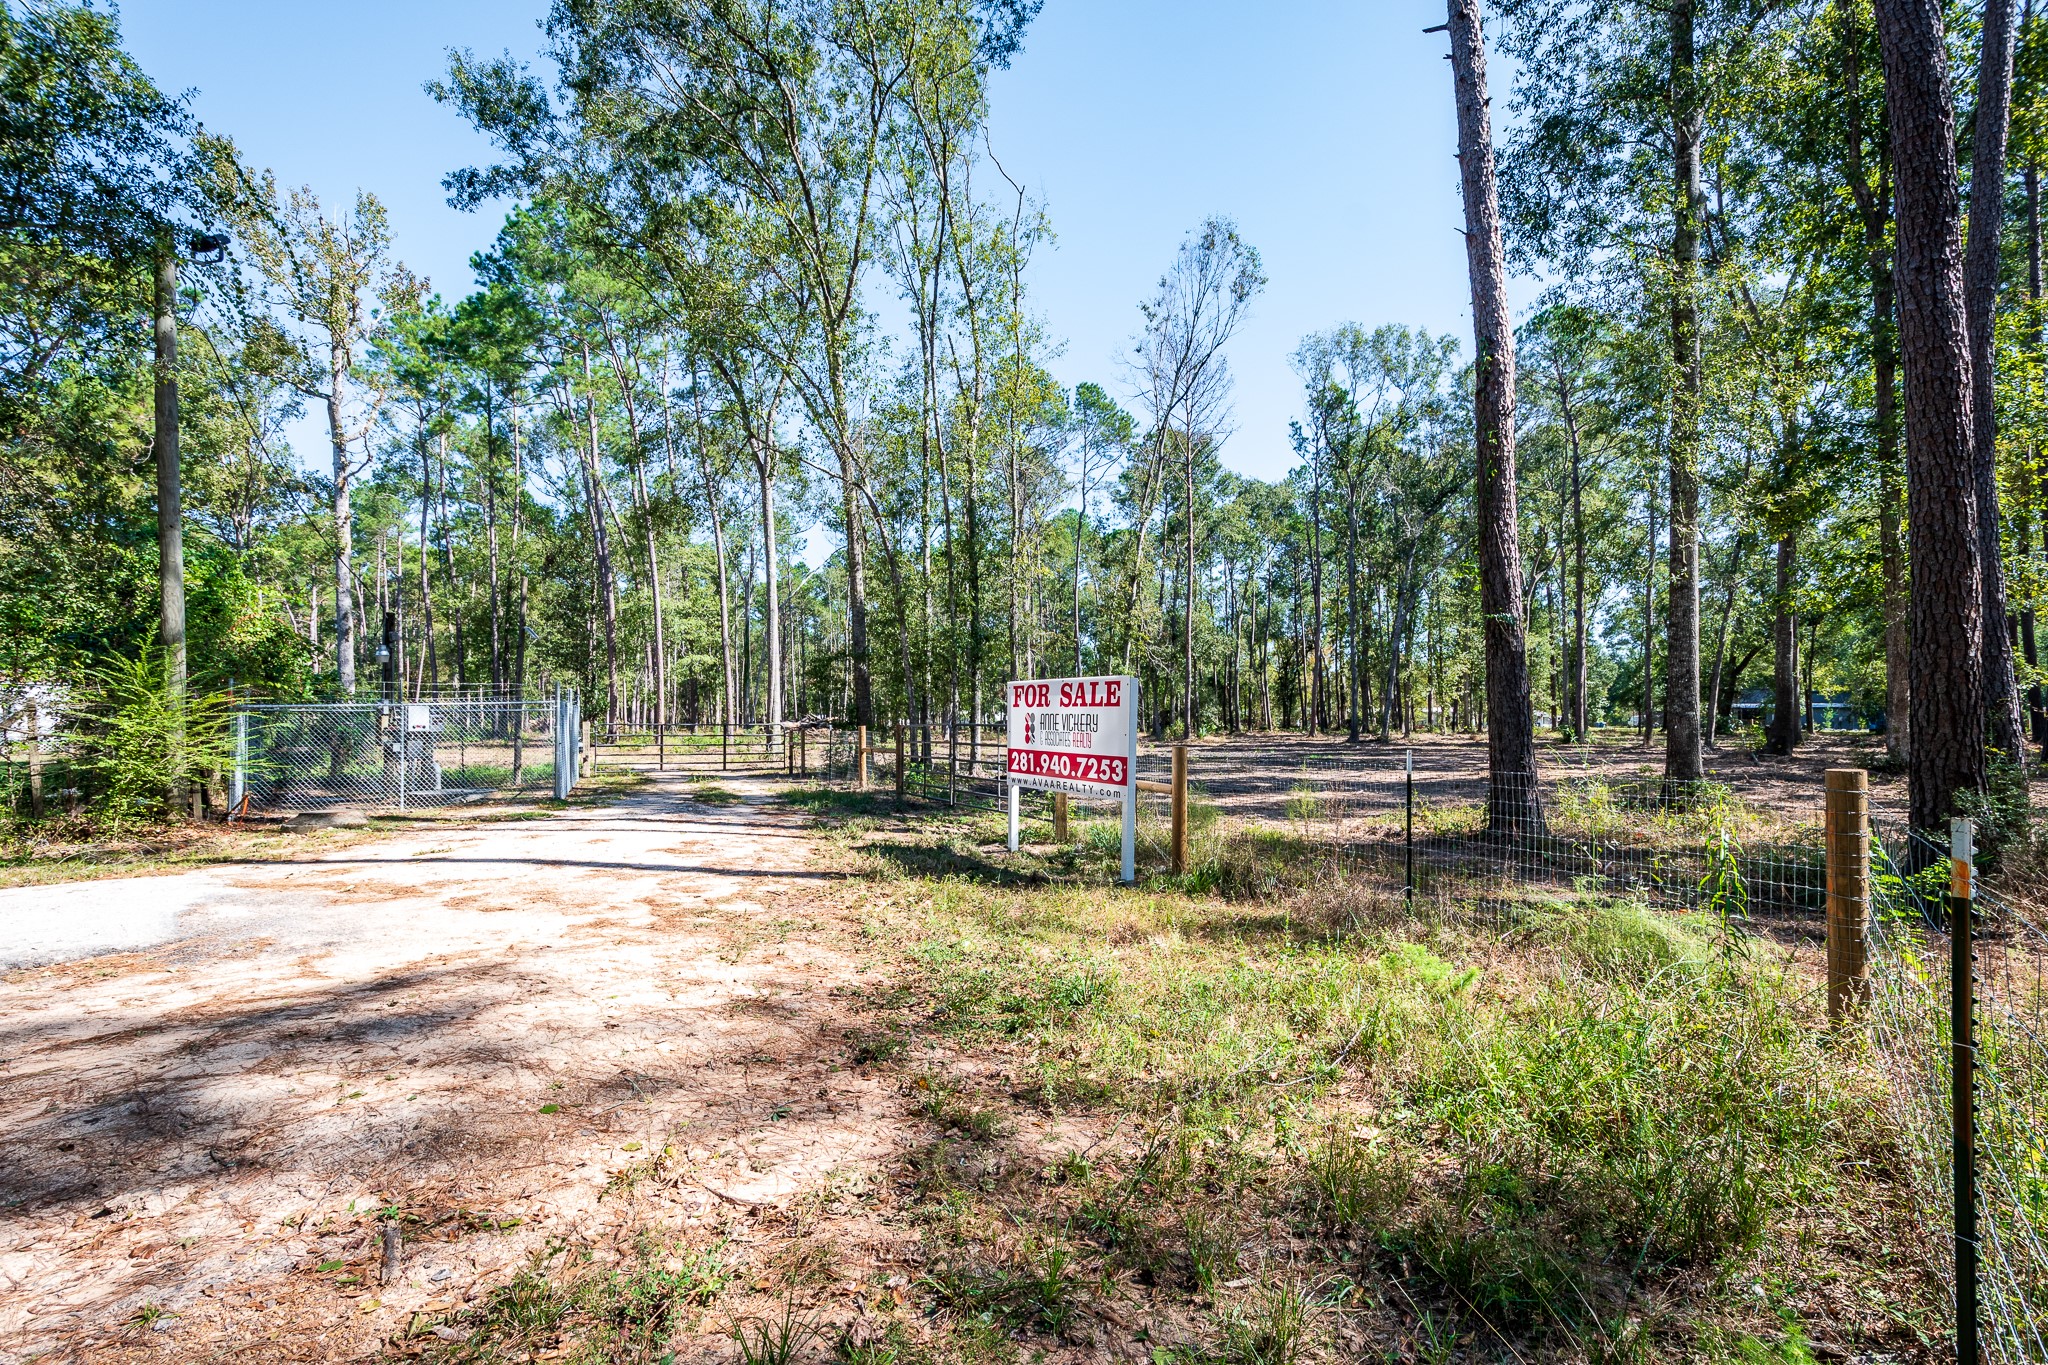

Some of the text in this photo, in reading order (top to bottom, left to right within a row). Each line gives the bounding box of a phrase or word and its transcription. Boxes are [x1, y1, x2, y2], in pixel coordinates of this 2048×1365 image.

[1013, 681, 1121, 708] FOR SALE
[1040, 713, 1099, 733] ANNE VICKERY
[1072, 732, 1092, 748] REALTY
[1011, 751, 1123, 782] 281.940.7253
[1011, 777, 1121, 799] www.AVAAREALTY.com
